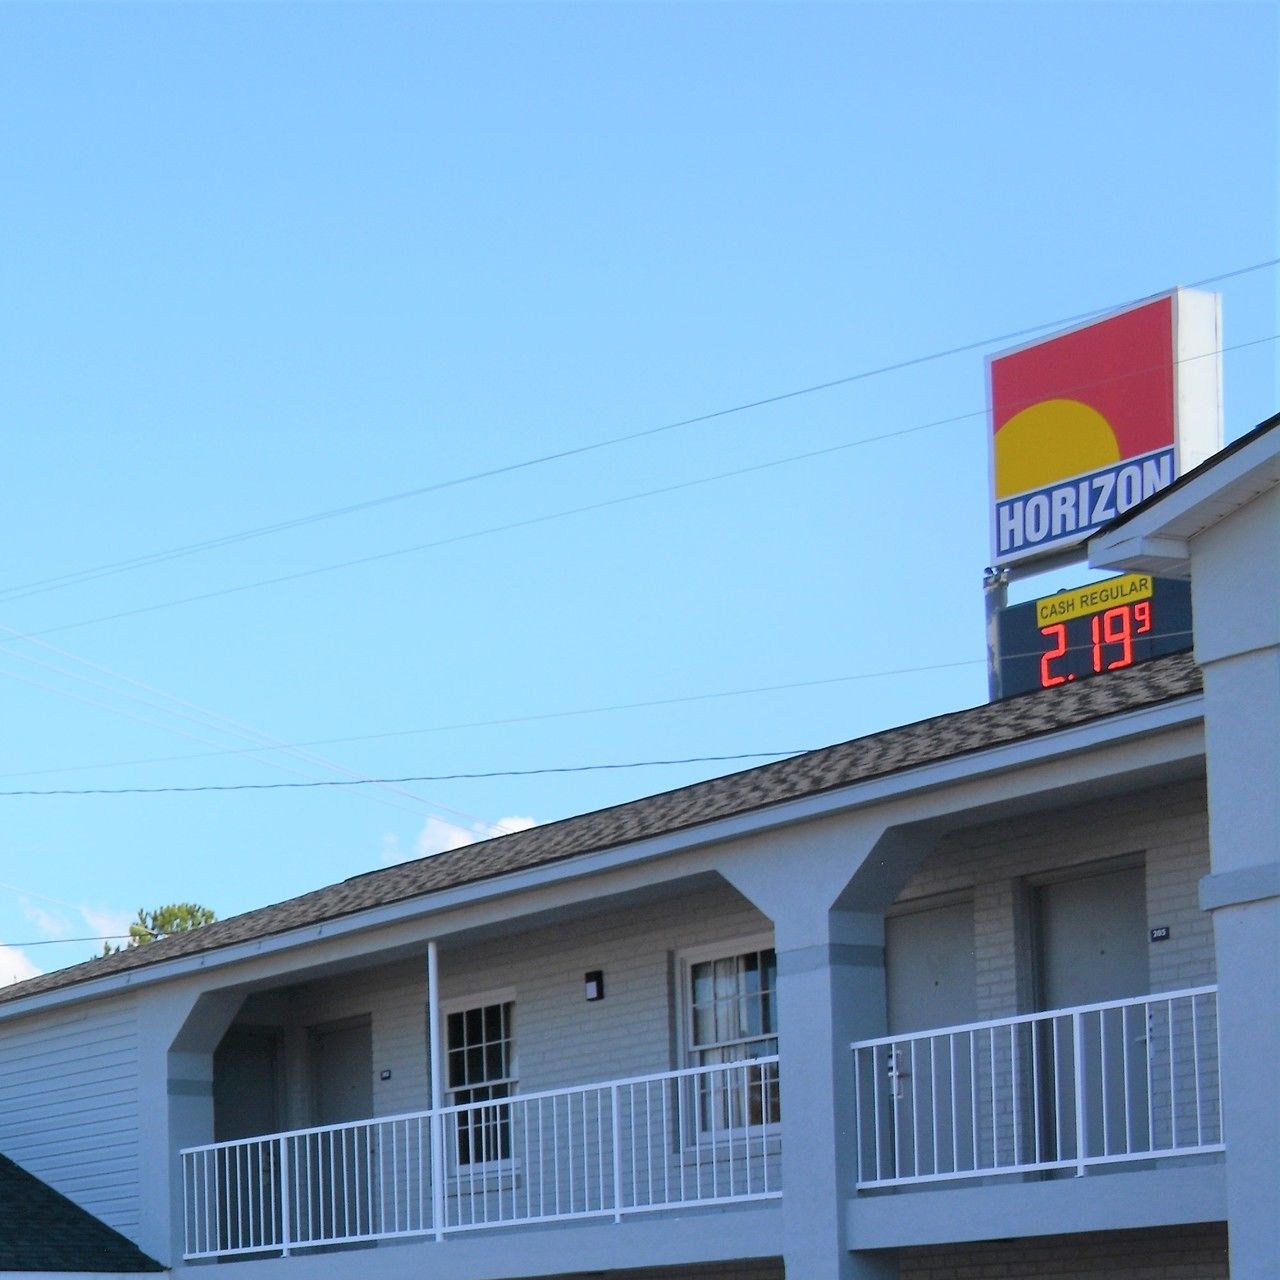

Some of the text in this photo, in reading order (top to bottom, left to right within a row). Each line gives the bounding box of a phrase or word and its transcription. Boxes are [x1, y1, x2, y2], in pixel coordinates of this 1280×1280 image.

[999, 454, 1171, 551] HORIZON
[1040, 578, 1148, 620] CASH REGULAR
